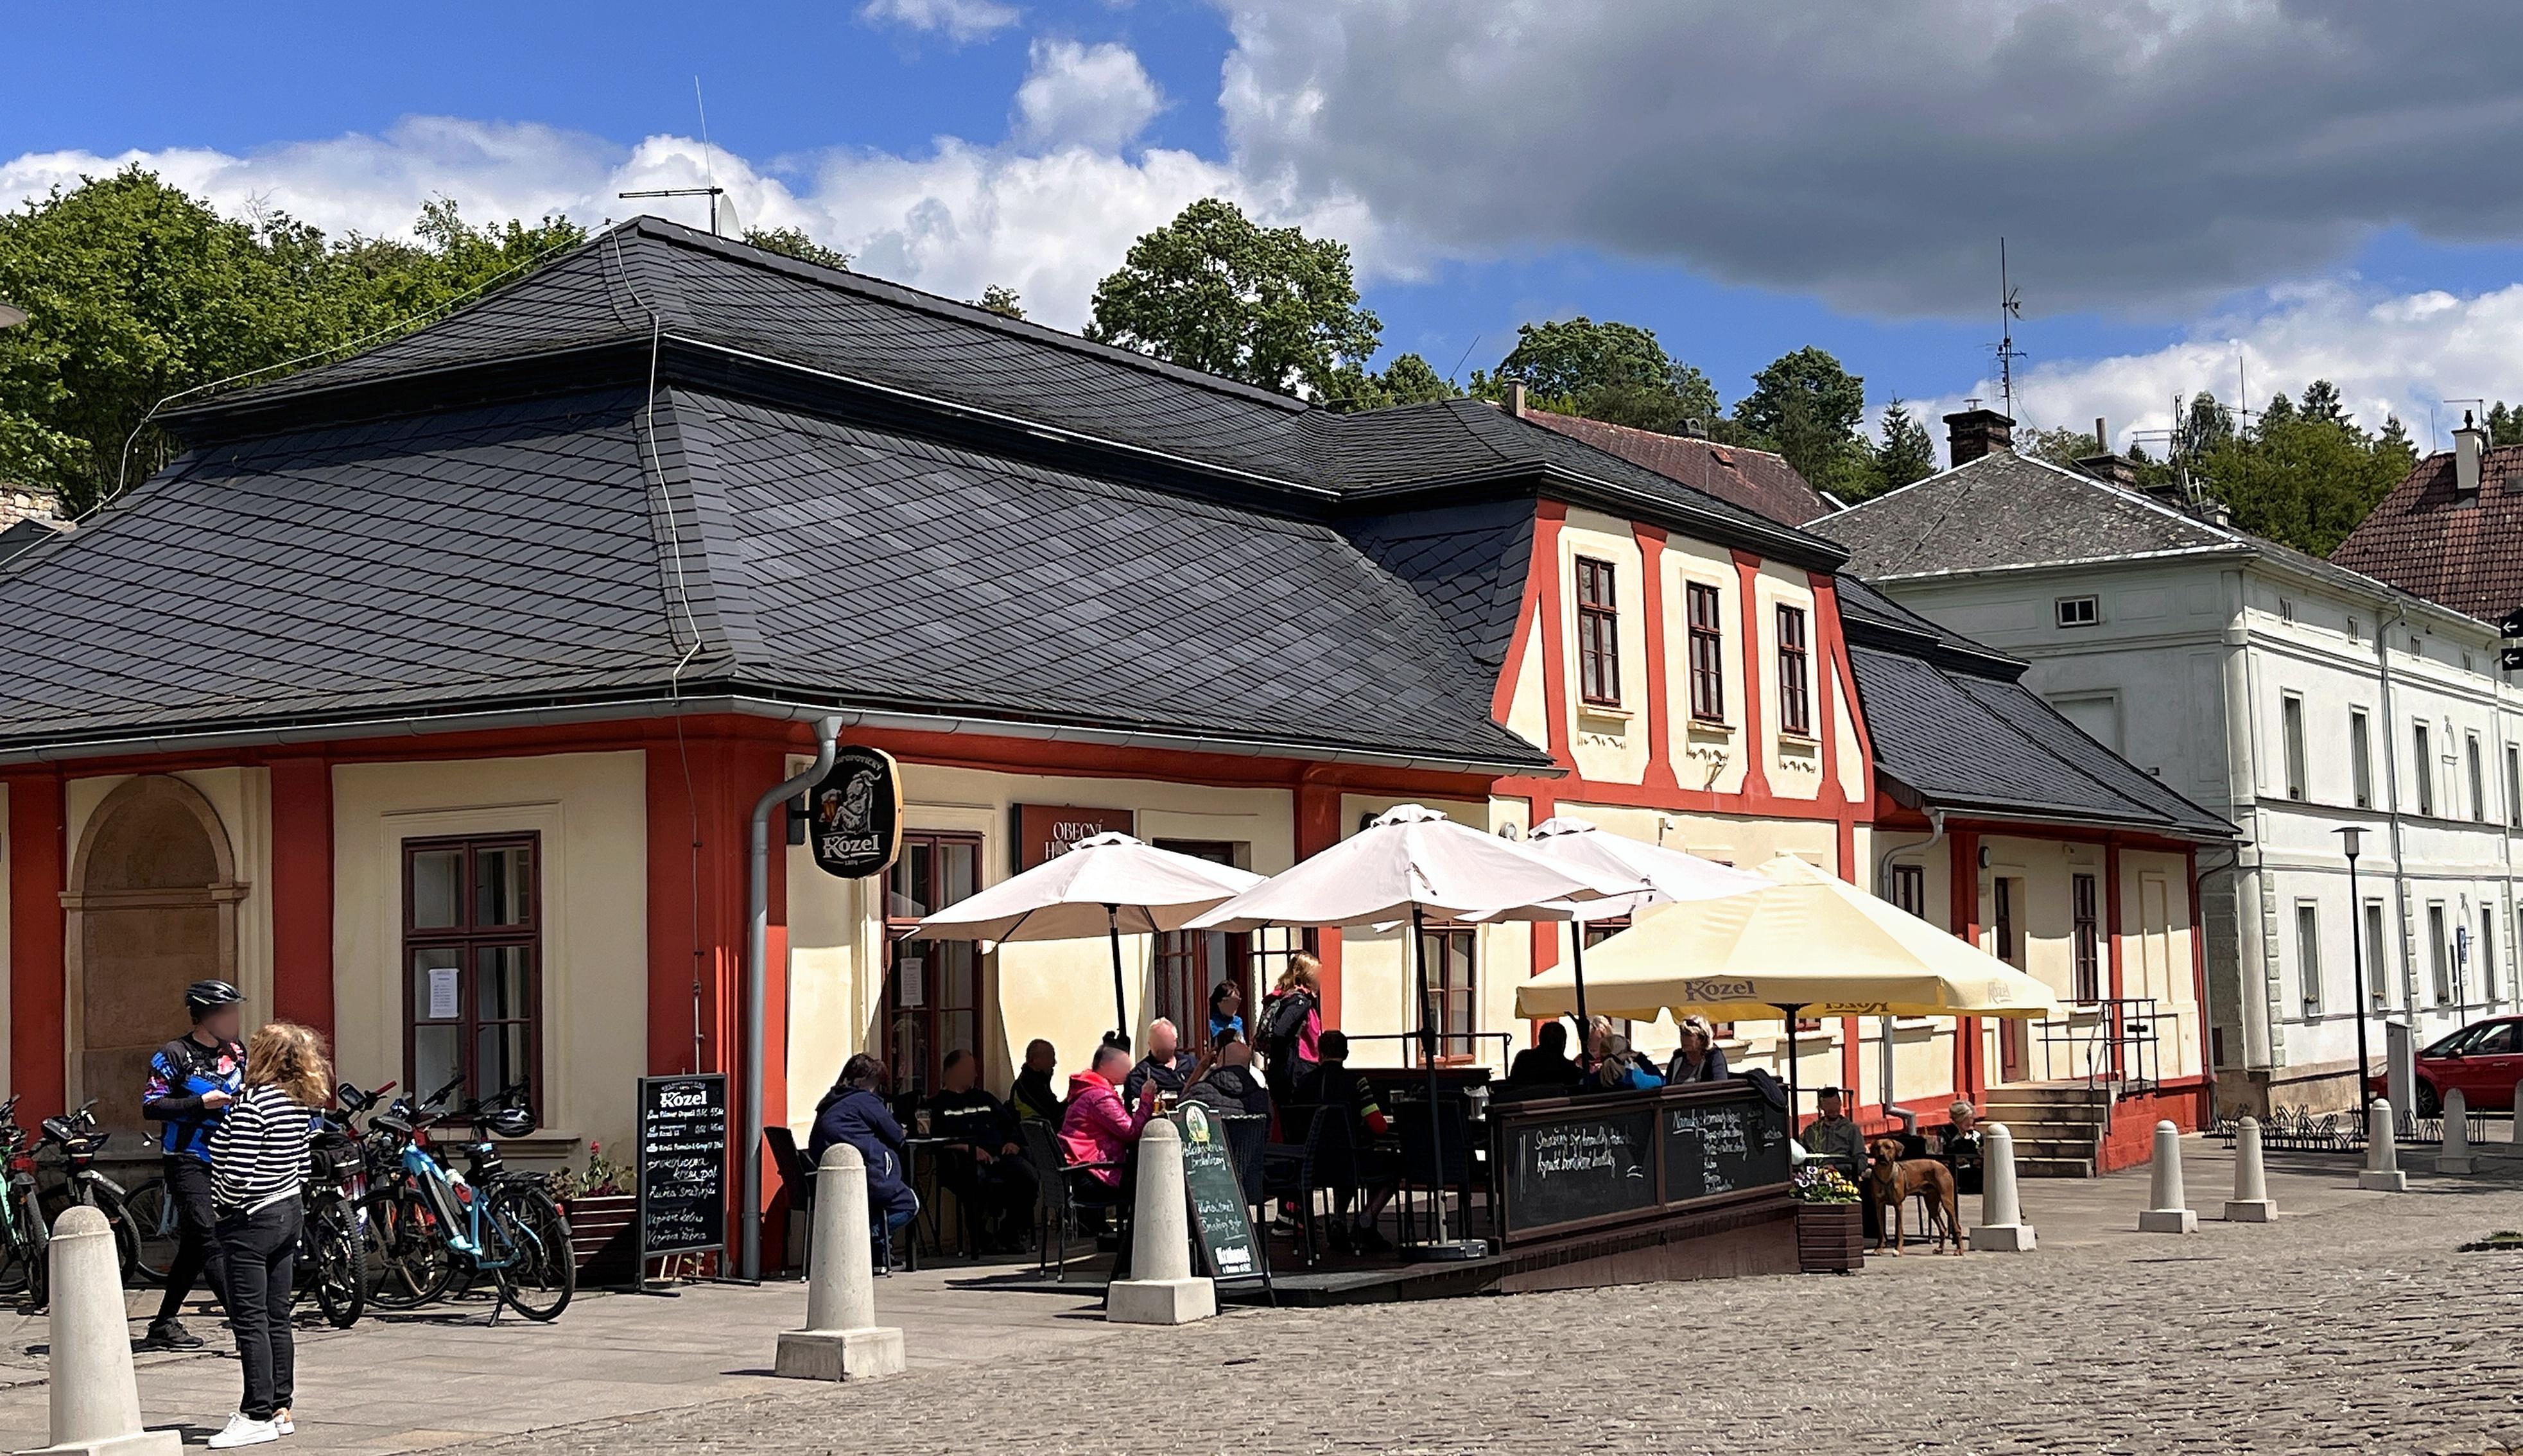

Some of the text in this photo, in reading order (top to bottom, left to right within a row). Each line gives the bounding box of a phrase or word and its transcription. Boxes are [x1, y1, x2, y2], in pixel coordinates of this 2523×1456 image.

[1053, 819, 1104, 840] OBECNÍ
[822, 835, 880, 859] Kozel
[1684, 980, 1756, 1001] Kozel
[660, 1091, 707, 1108] Kozel
